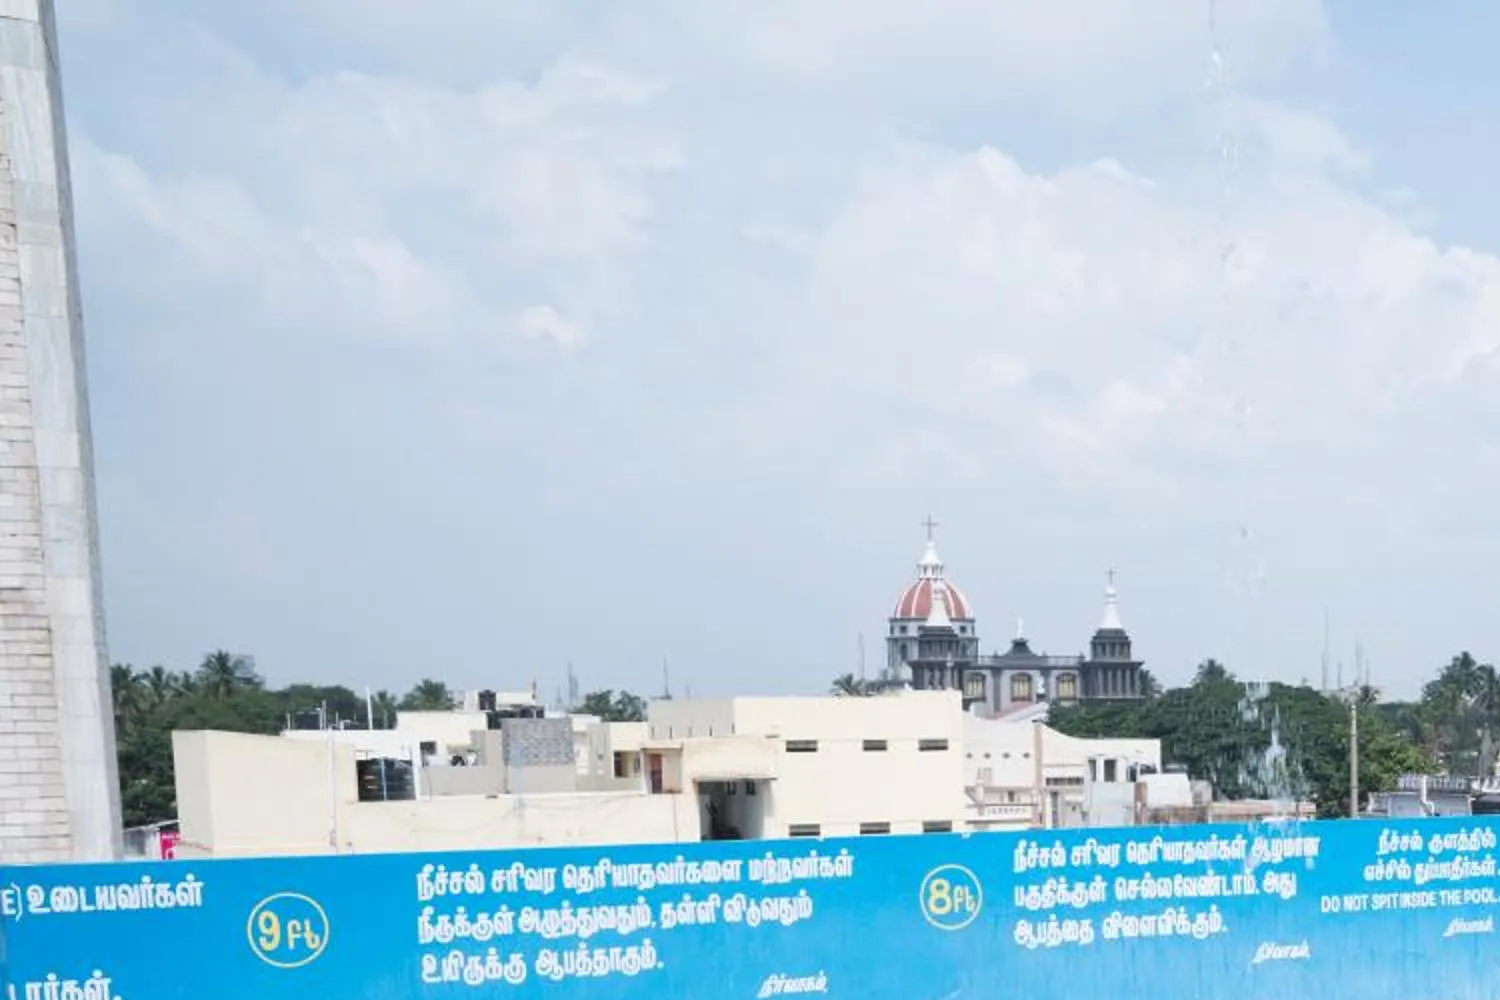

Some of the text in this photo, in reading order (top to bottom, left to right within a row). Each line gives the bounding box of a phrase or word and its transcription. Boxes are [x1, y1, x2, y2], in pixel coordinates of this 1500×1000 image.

[1013, 838, 1066, 873] நீச்சல்
[1071, 837, 1121, 868] சரிவர
[1376, 826, 1497, 855] நீச்சல் குளத்தில்
[416, 848, 854, 901] நீச்சல் சரிவர தெரியாதவர்களை மற்றவர்கள்
[1363, 858, 1411, 881] எச்சில்
[26, 873, 204, 914] உடையவர்கள்
[1014, 874, 1107, 910] பகுதிக்குள்
[1263, 870, 1297, 899] அது
[1321, 895, 1340, 912] DO
[1343, 893, 1369, 911] NOT
[1371, 892, 1399, 910] SPIT
[1400, 890, 1437, 910] INSIDE
[1439, 888, 1462, 906] THE
[417, 904, 514, 944] நீருக்குள்
[660, 893, 721, 928] தள்ளி
[723, 888, 813, 927] விடுவதும்
[1014, 913, 1094, 949] ஆபத்தை
[421, 938, 664, 985] உயிருக்கு ஆபத்தாகும்.
